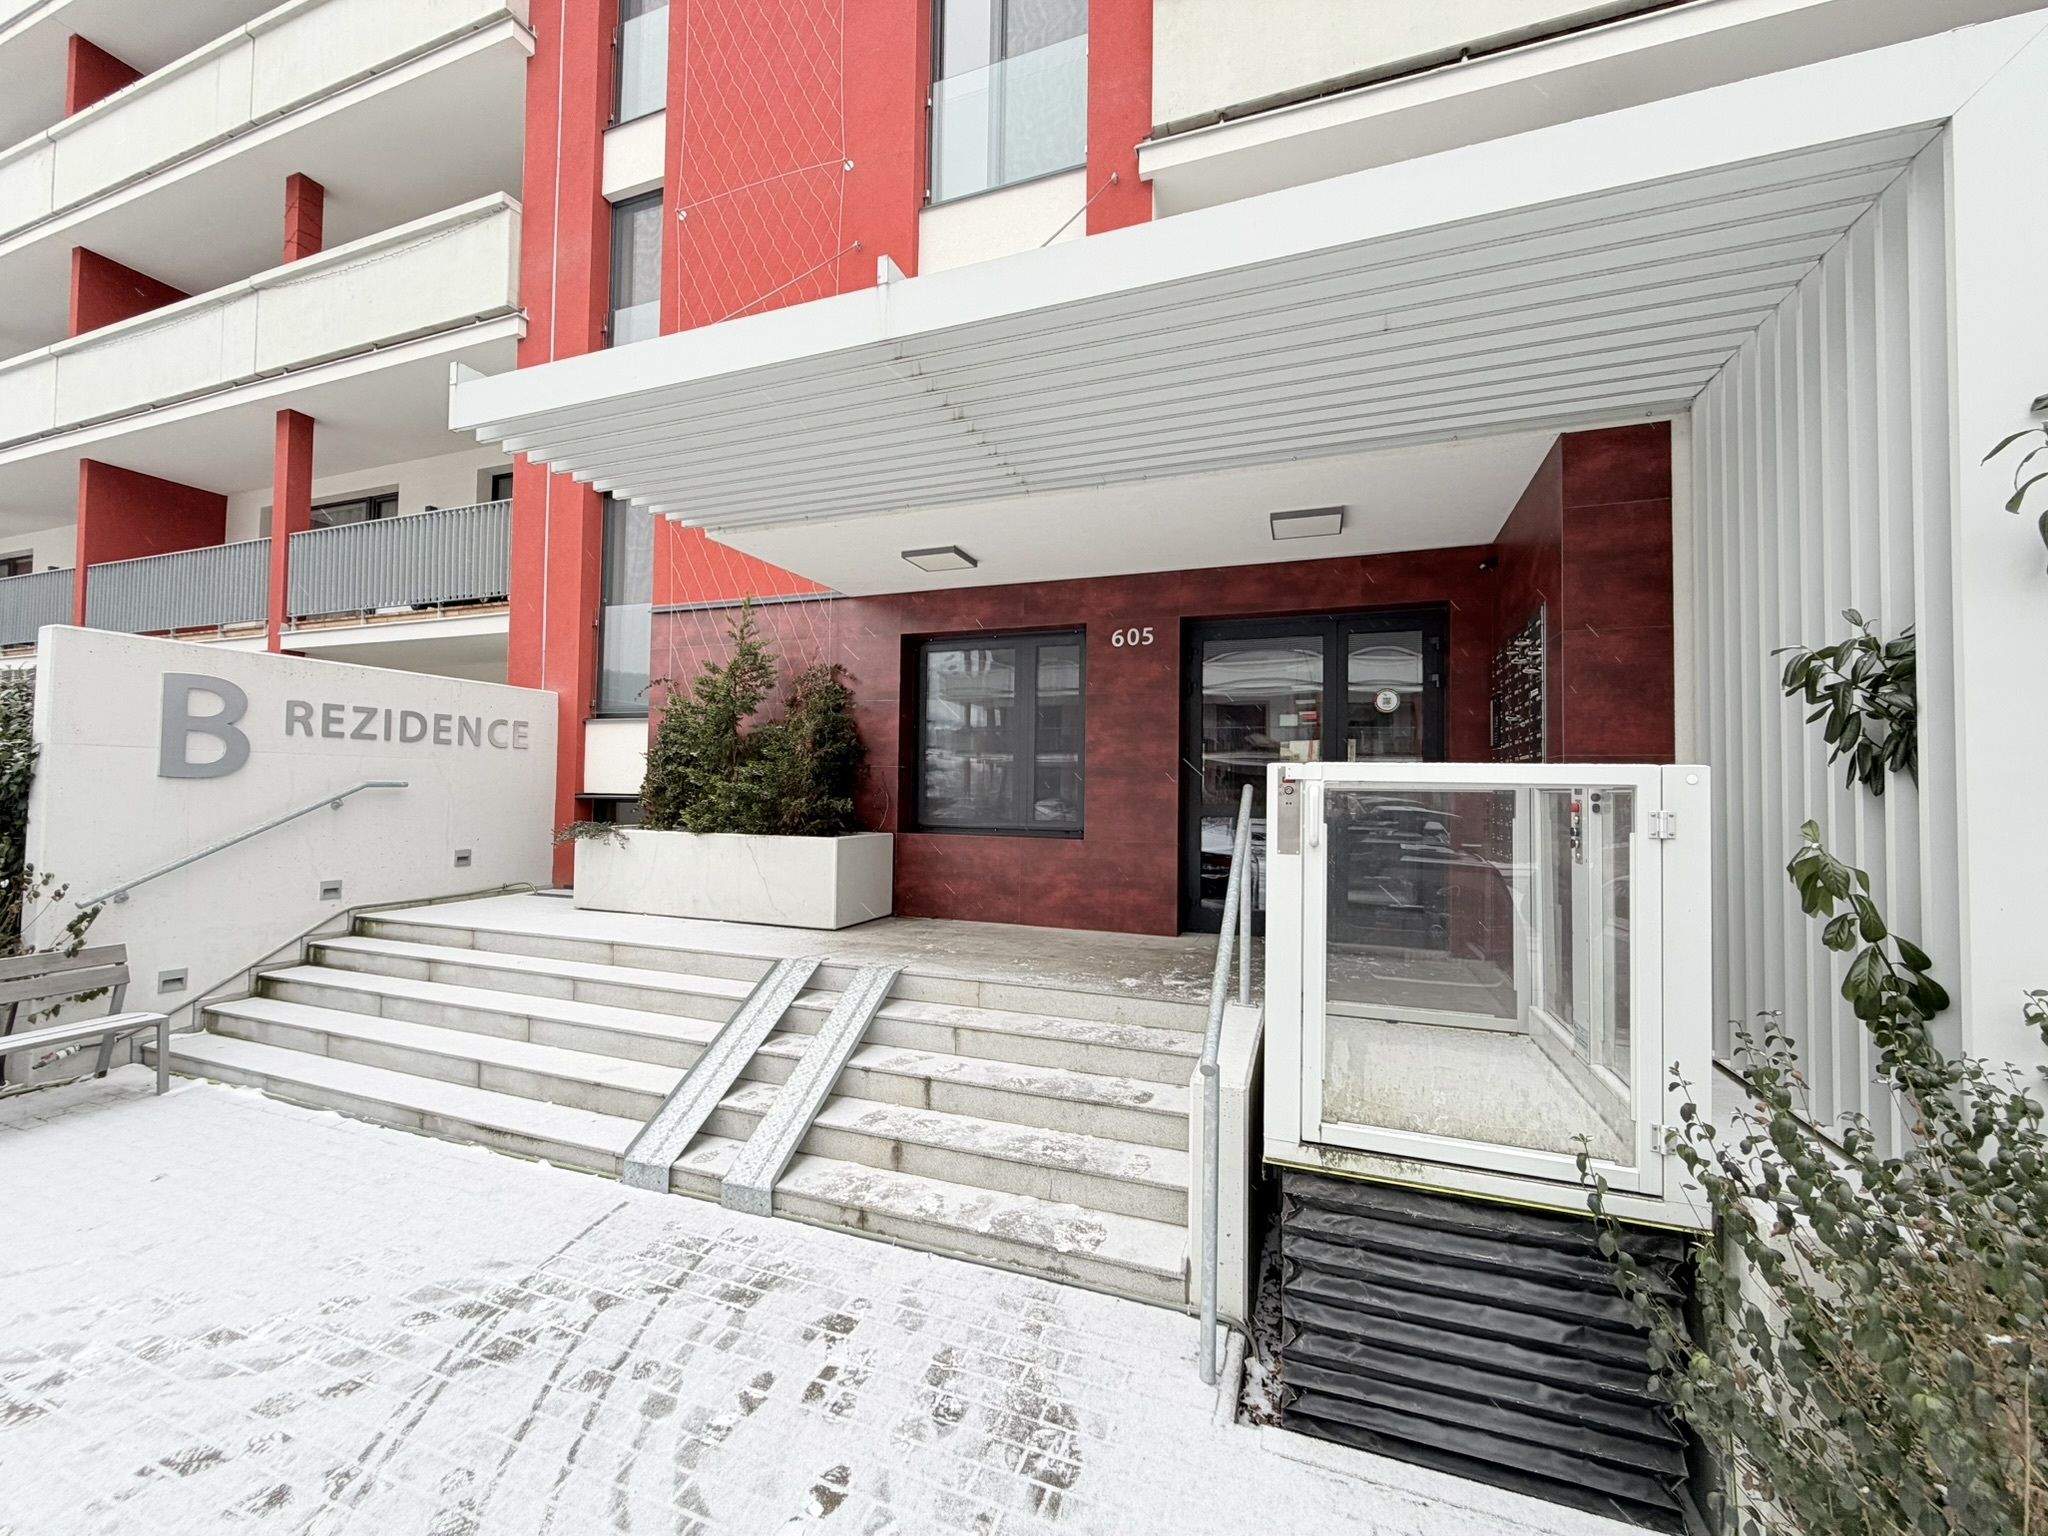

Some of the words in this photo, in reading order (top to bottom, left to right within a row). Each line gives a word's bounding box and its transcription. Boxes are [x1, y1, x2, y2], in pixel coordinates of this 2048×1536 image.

[1111, 627, 1154, 648] 605
[158, 671, 251, 779] B
[285, 700, 529, 750] REZIDENCE
